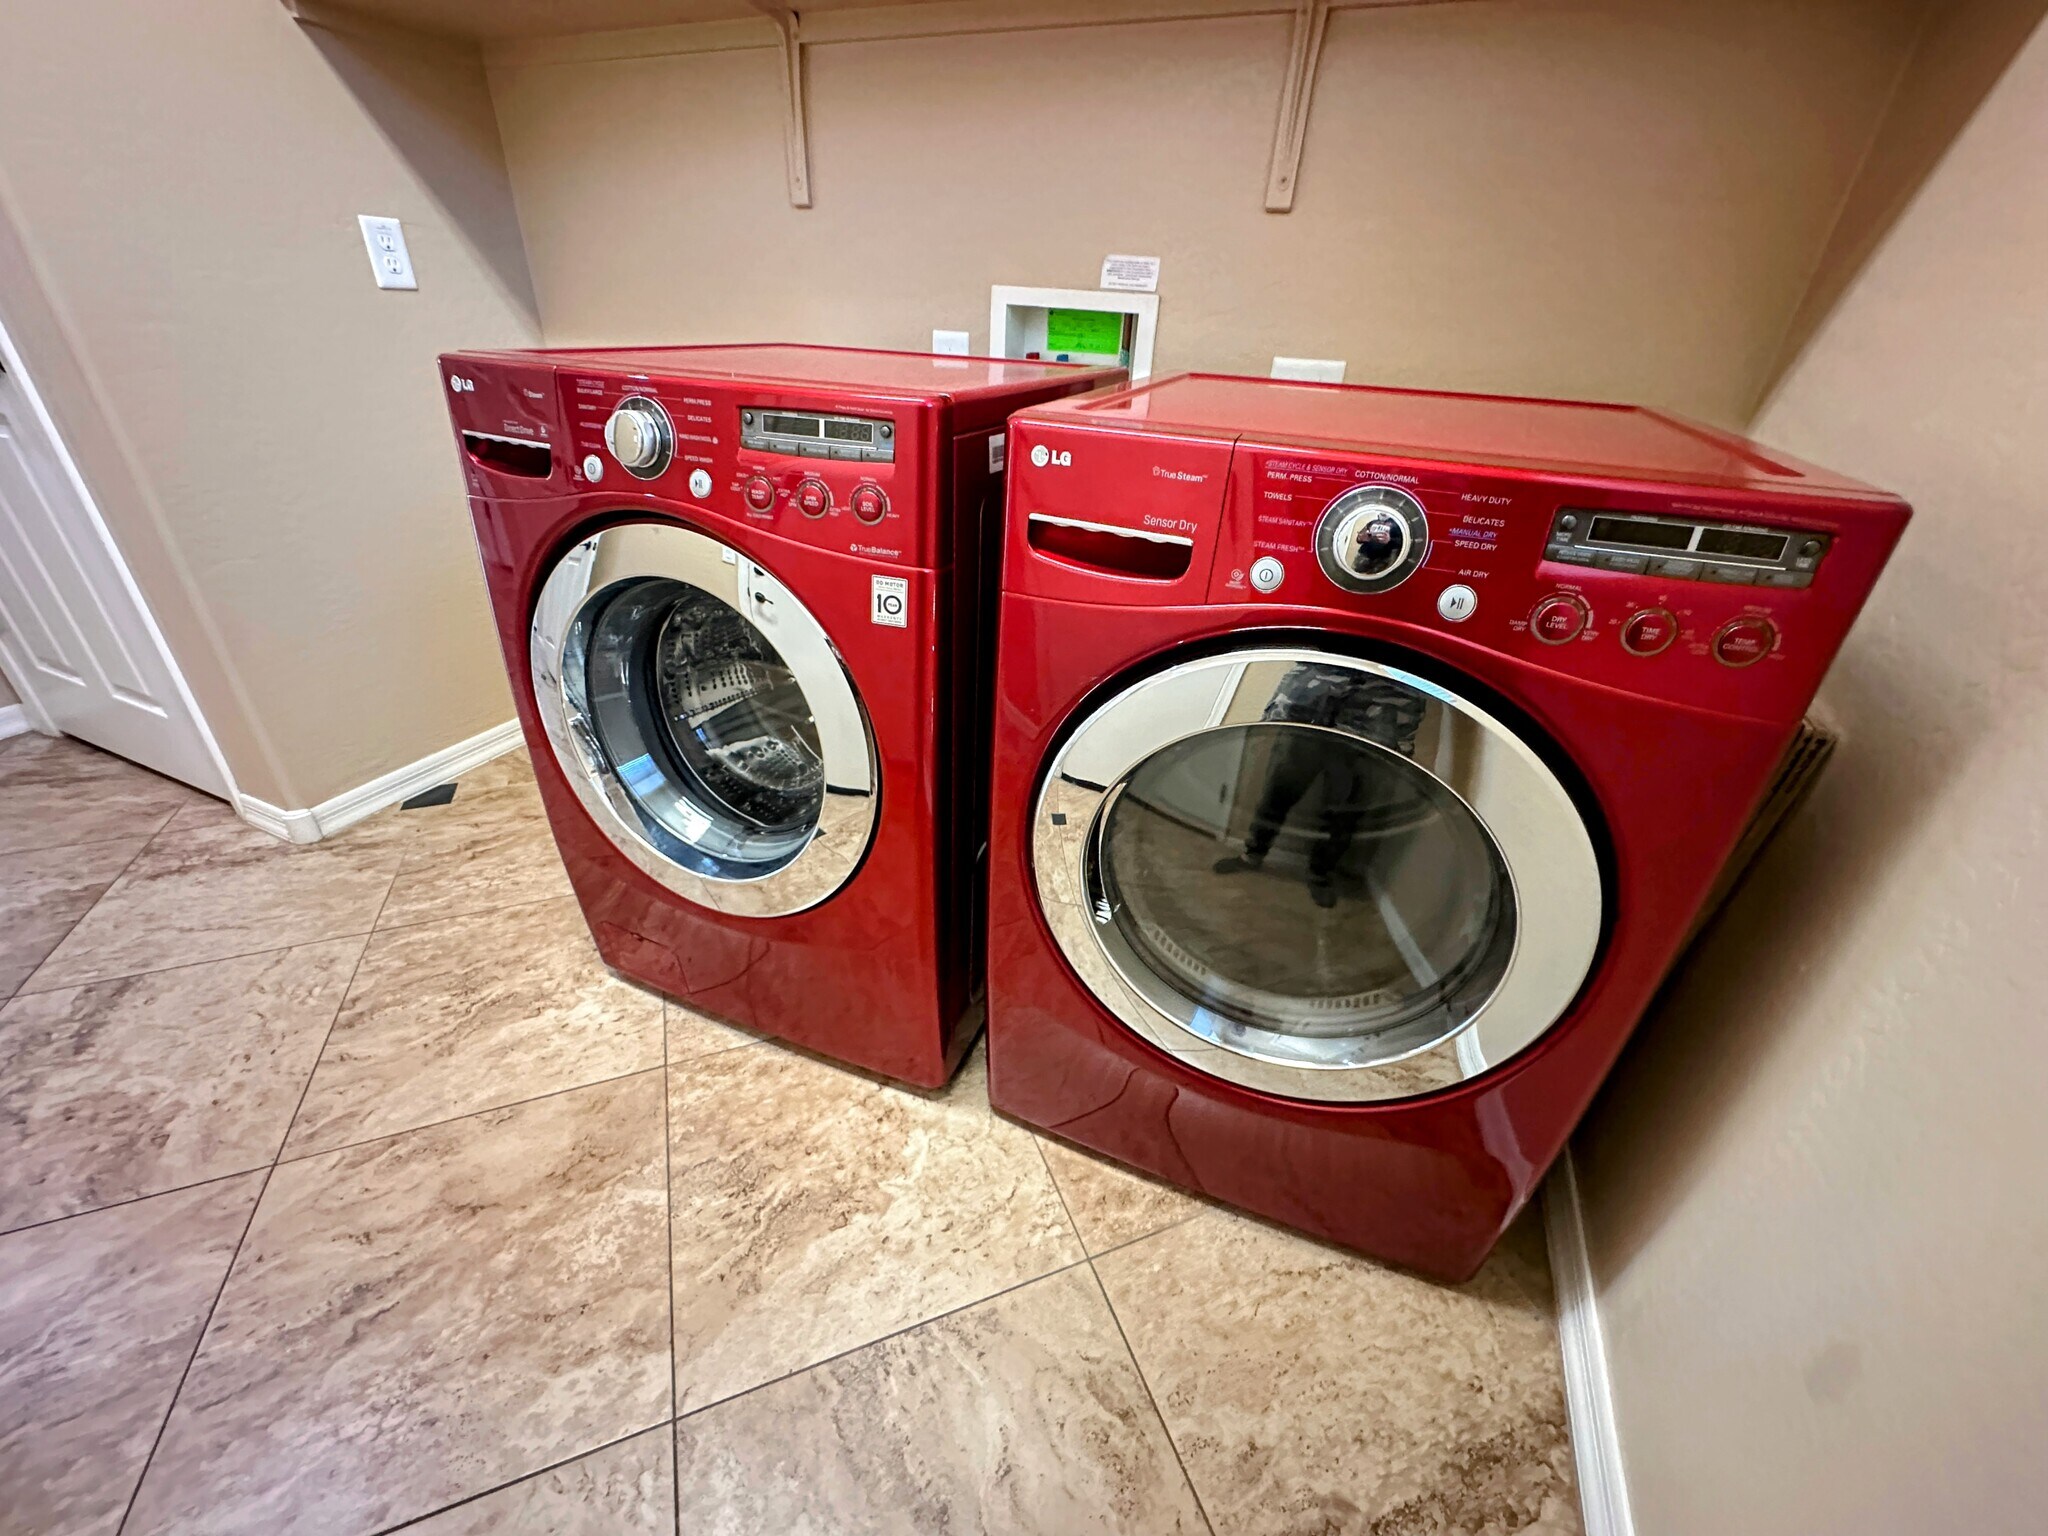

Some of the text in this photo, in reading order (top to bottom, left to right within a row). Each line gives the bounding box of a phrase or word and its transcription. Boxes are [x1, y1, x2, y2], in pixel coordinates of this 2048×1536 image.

[461, 378, 474, 391] LG
[687, 414, 712, 423] DELICATES
[1051, 450, 1072, 467] LG
[1287, 461, 1306, 471] CYCLE
[1312, 464, 1335, 474] SENSOR
[1335, 467, 1348, 475] DRY
[1267, 471, 1312, 483] PERM. PRESS
[1354, 470, 1419, 484] COTTON/NORMAL
[1263, 491, 1292, 501] TOWELS
[1461, 493, 1512, 506] HEAVY DUTY
[1143, 514, 1198, 534] Sensor Dry
[1258, 515, 1278, 524] STEAM
[1462, 515, 1505, 527] DELICATES
[1482, 531, 1498, 539] DRY
[1253, 541, 1275, 550] STEAM
[1454, 540, 1497, 551] SPEED DRY
[1472, 570, 1490, 578] DRY
[885, 580, 904, 588] MOTOR
[1556, 583, 1582, 591] NORMAL
[877, 594, 902, 615] 10
[1546, 622, 1567, 630] LEVEL
[1642, 626, 1661, 635] TIME
